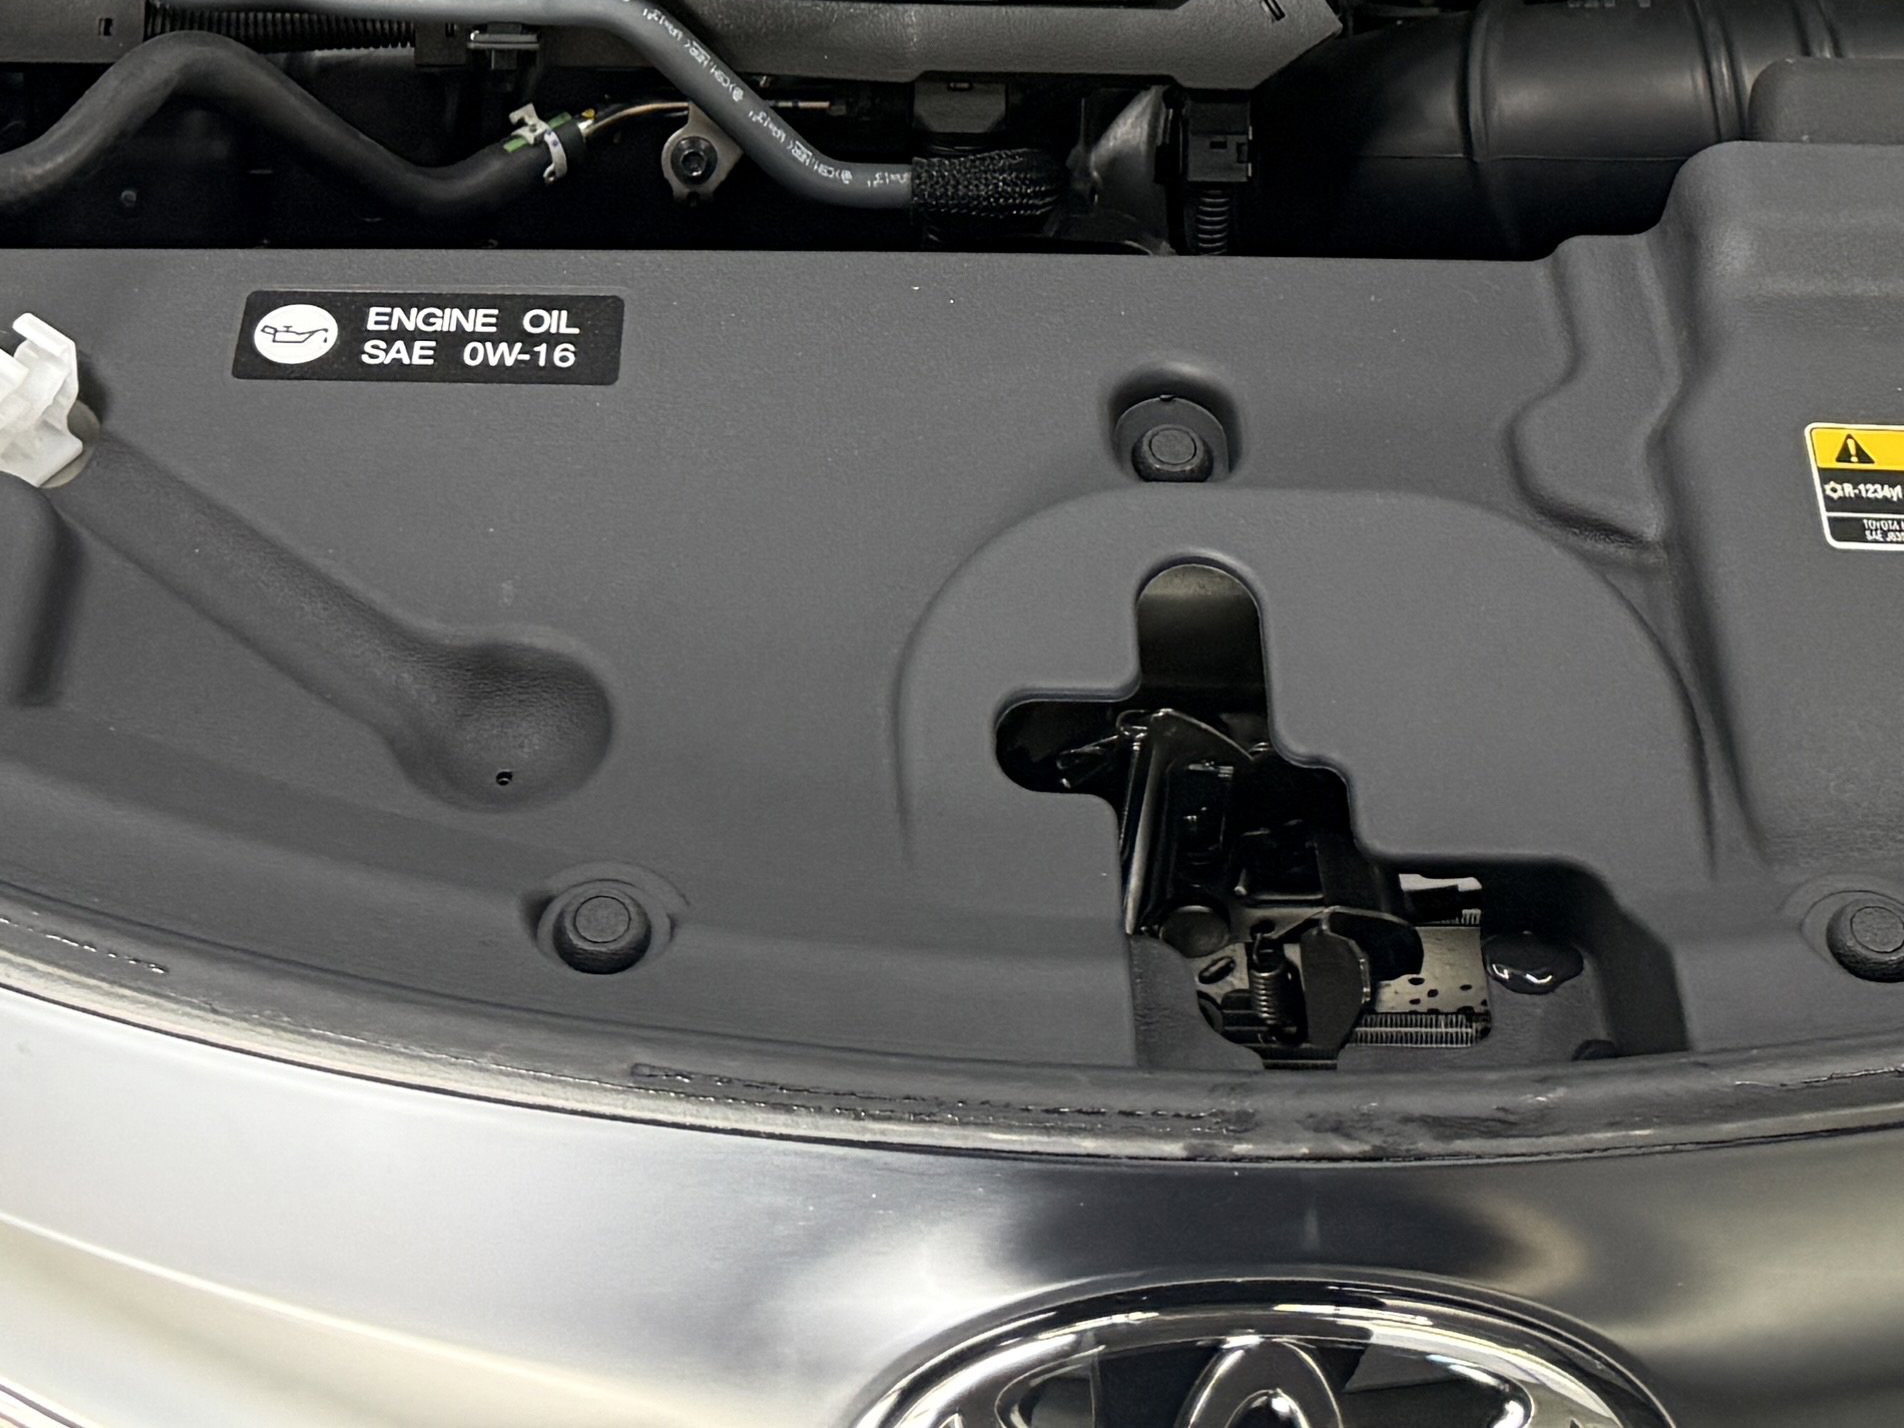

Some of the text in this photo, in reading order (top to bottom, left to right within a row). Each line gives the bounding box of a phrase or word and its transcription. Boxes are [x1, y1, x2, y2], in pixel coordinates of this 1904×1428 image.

[366, 306, 581, 335] ENGINE OIL
[360, 340, 577, 369] SAE 0W-16
[1842, 482, 1904, 502] R-1234yf
[1862, 518, 1900, 531] TOYOTA
[1865, 530, 1885, 542] SAE
